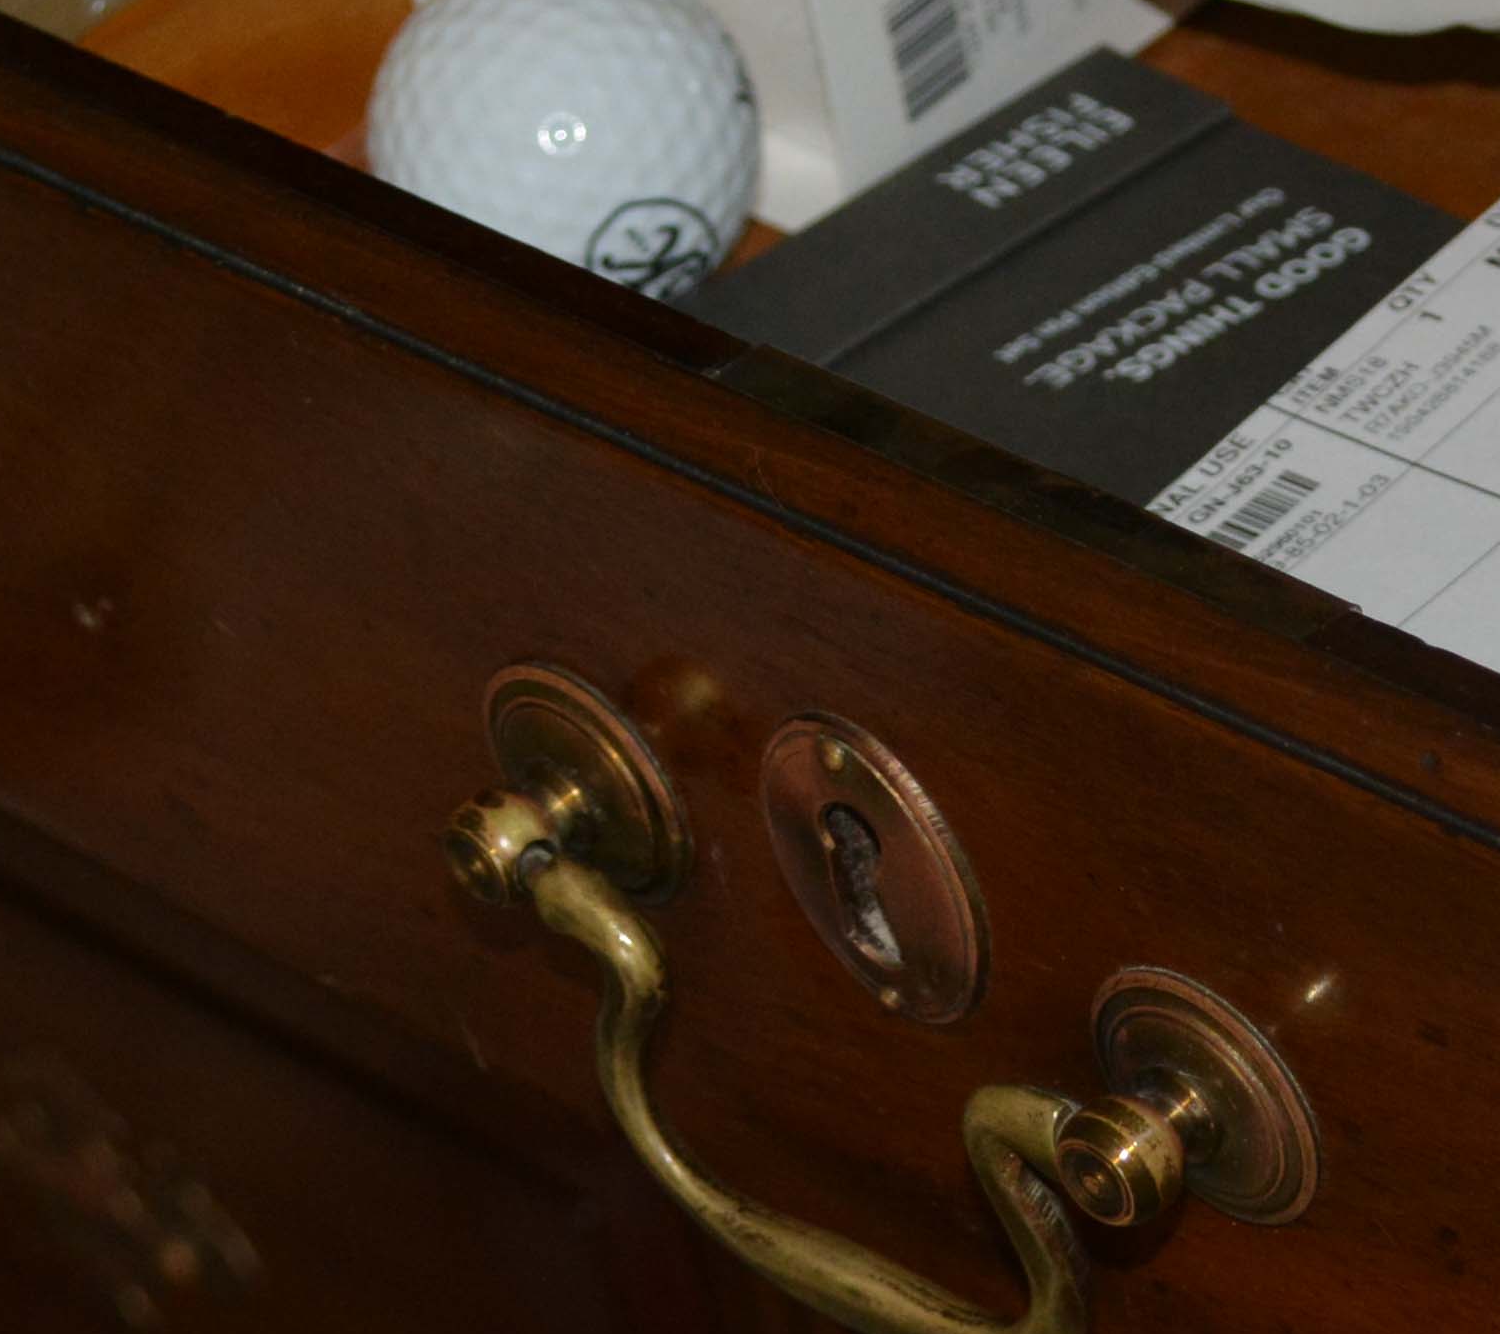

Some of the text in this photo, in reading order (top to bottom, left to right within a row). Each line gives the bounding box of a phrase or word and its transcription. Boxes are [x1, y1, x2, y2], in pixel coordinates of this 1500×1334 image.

[936, 91, 1102, 192] FISHER
[969, 105, 1137, 208] EILEEN
[1022, 204, 1335, 389] SMALL PACKAGE.
[1103, 225, 1372, 382] GOOD THINGS.
[1388, 272, 1438, 313] QTY
[1418, 310, 1443, 322] 1
[1291, 366, 1341, 406] ITEM
[1343, 361, 1421, 420] TWCZH
[1187, 437, 1294, 526] GN-J63-10
[1200, 433, 1255, 479] USE
